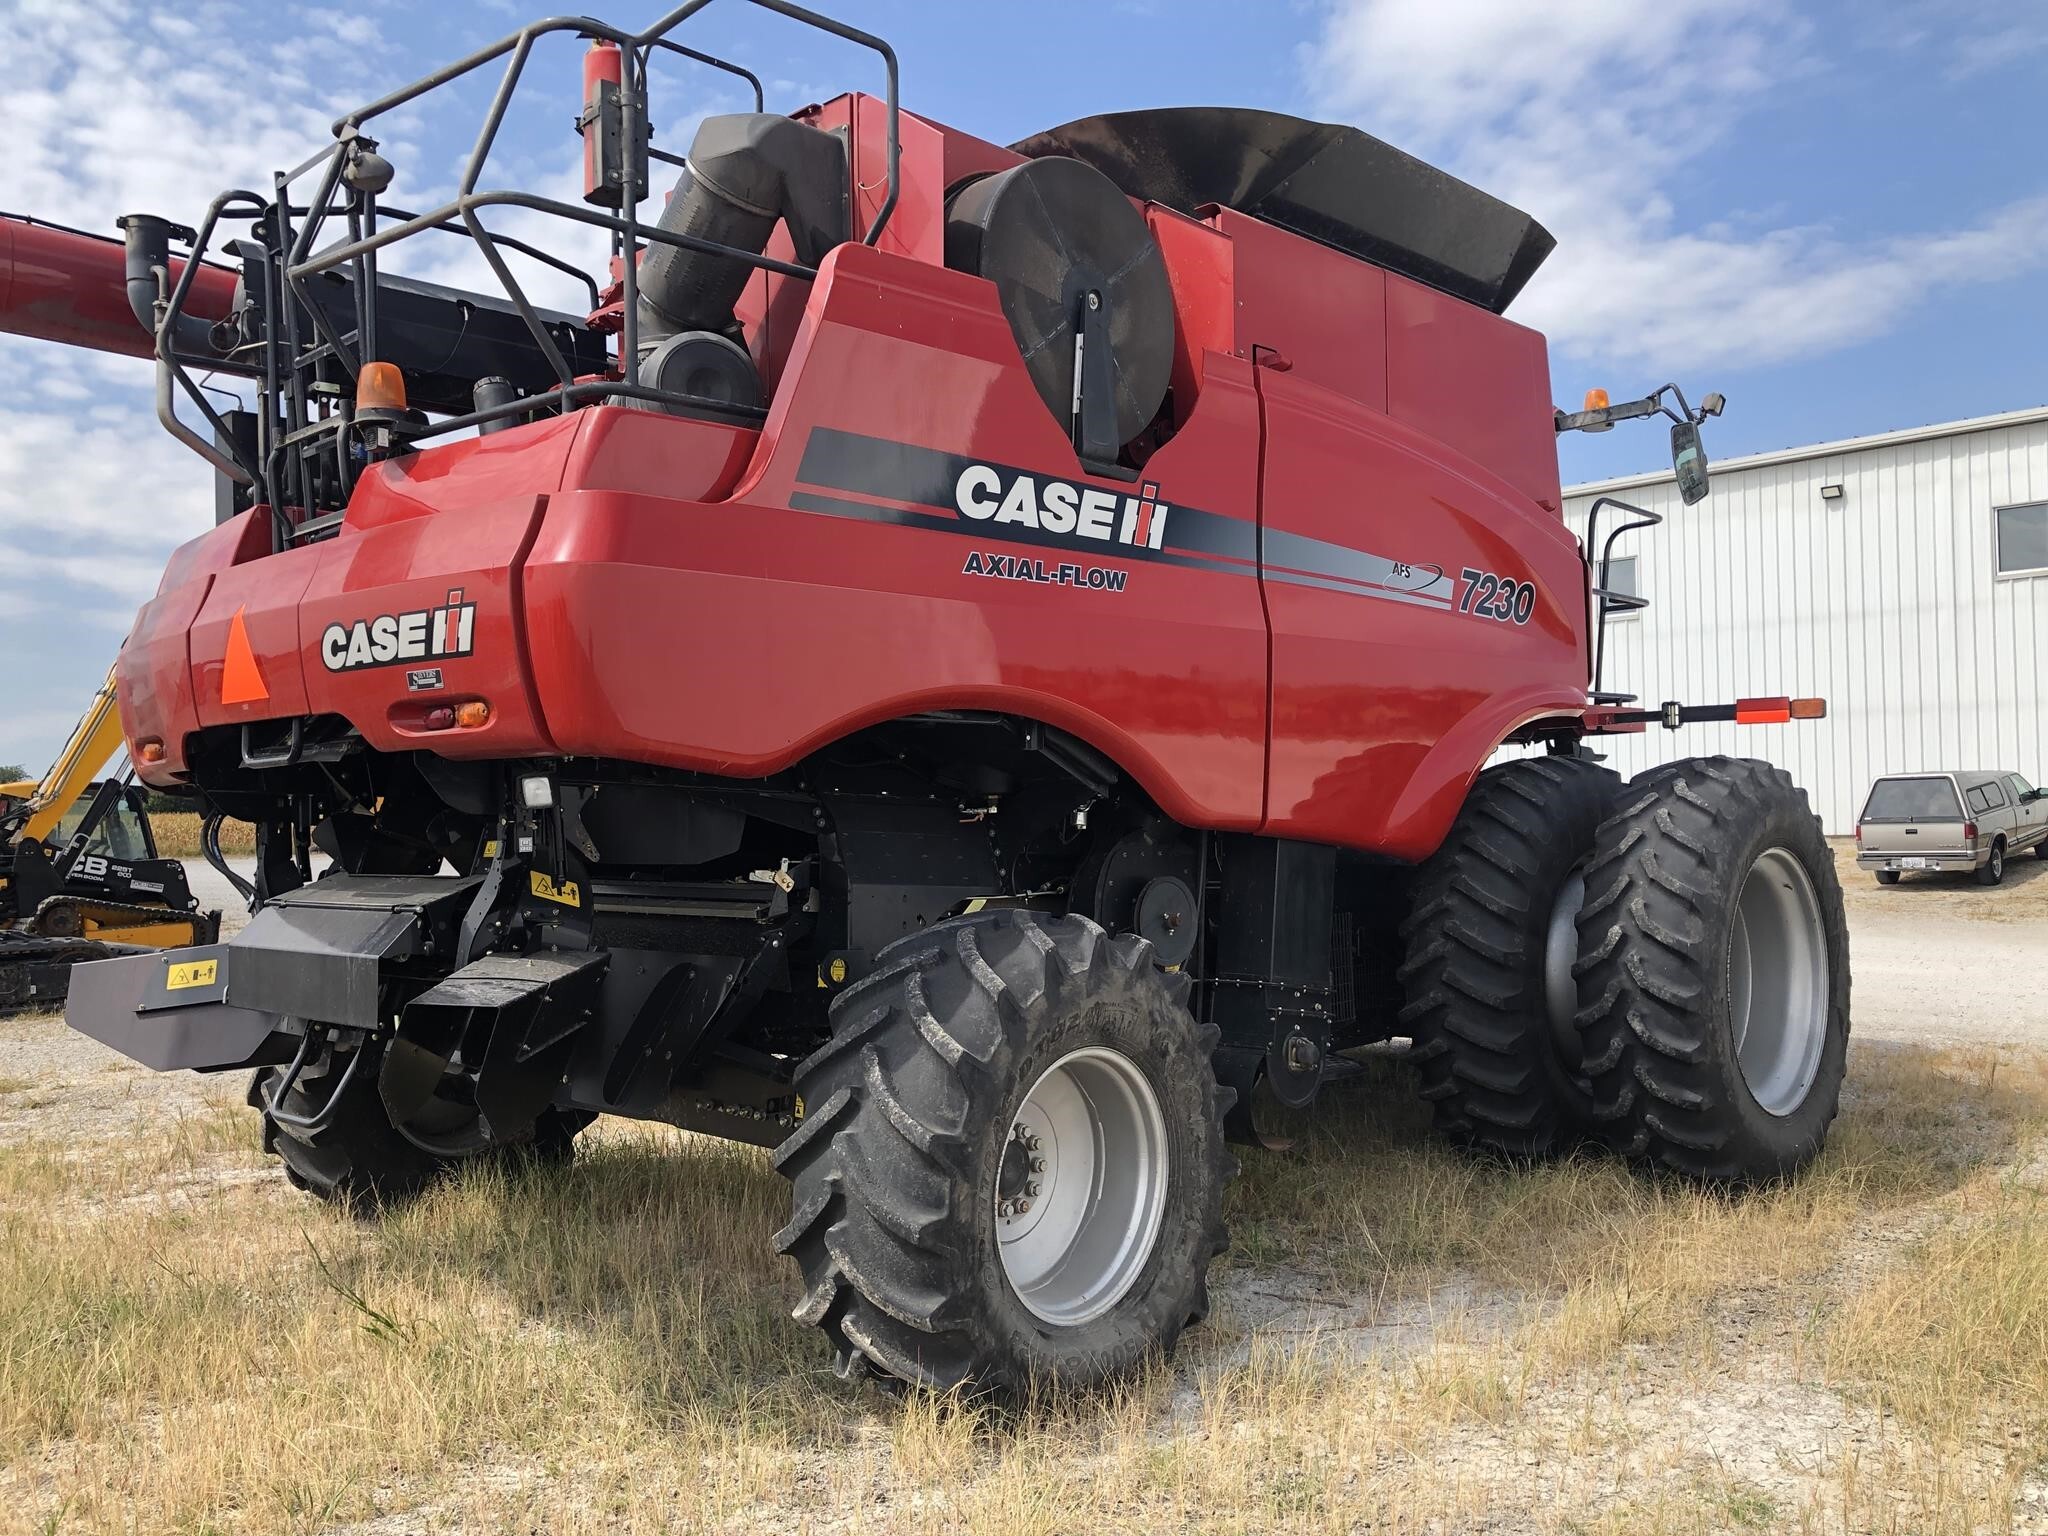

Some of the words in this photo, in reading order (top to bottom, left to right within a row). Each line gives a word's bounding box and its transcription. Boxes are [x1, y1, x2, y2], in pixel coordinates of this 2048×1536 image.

[955, 465, 1118, 541] CASE
[962, 551, 1128, 592] AXIAL-FLOW
[1392, 562, 1411, 579] AFS
[1459, 567, 1536, 625] 7230
[322, 612, 427, 670] CASE
